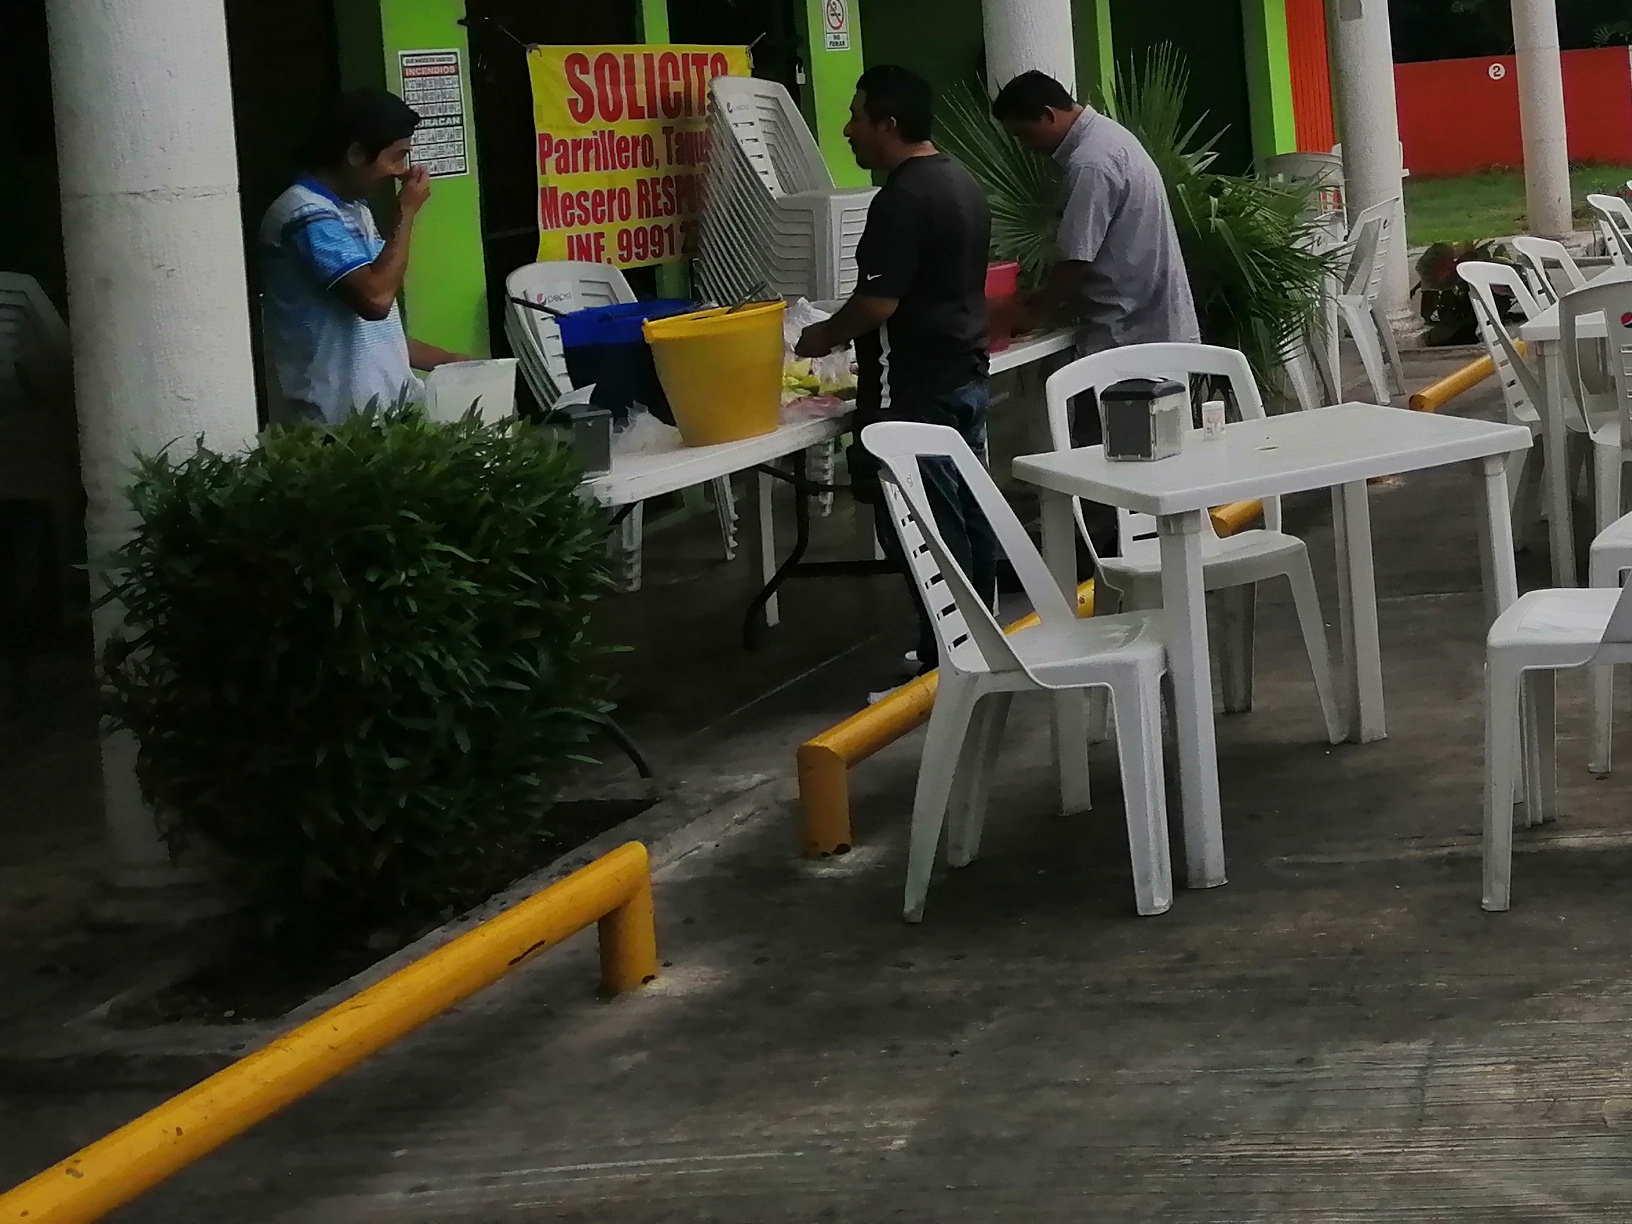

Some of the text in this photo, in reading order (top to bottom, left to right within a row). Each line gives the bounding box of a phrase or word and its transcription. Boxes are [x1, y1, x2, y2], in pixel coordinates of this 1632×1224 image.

[405, 66, 455, 76] INCENDIOS
[1492, 65, 1502, 78] 2
[538, 129, 660, 176] Parrillero,
[540, 185, 631, 230] Mesero
